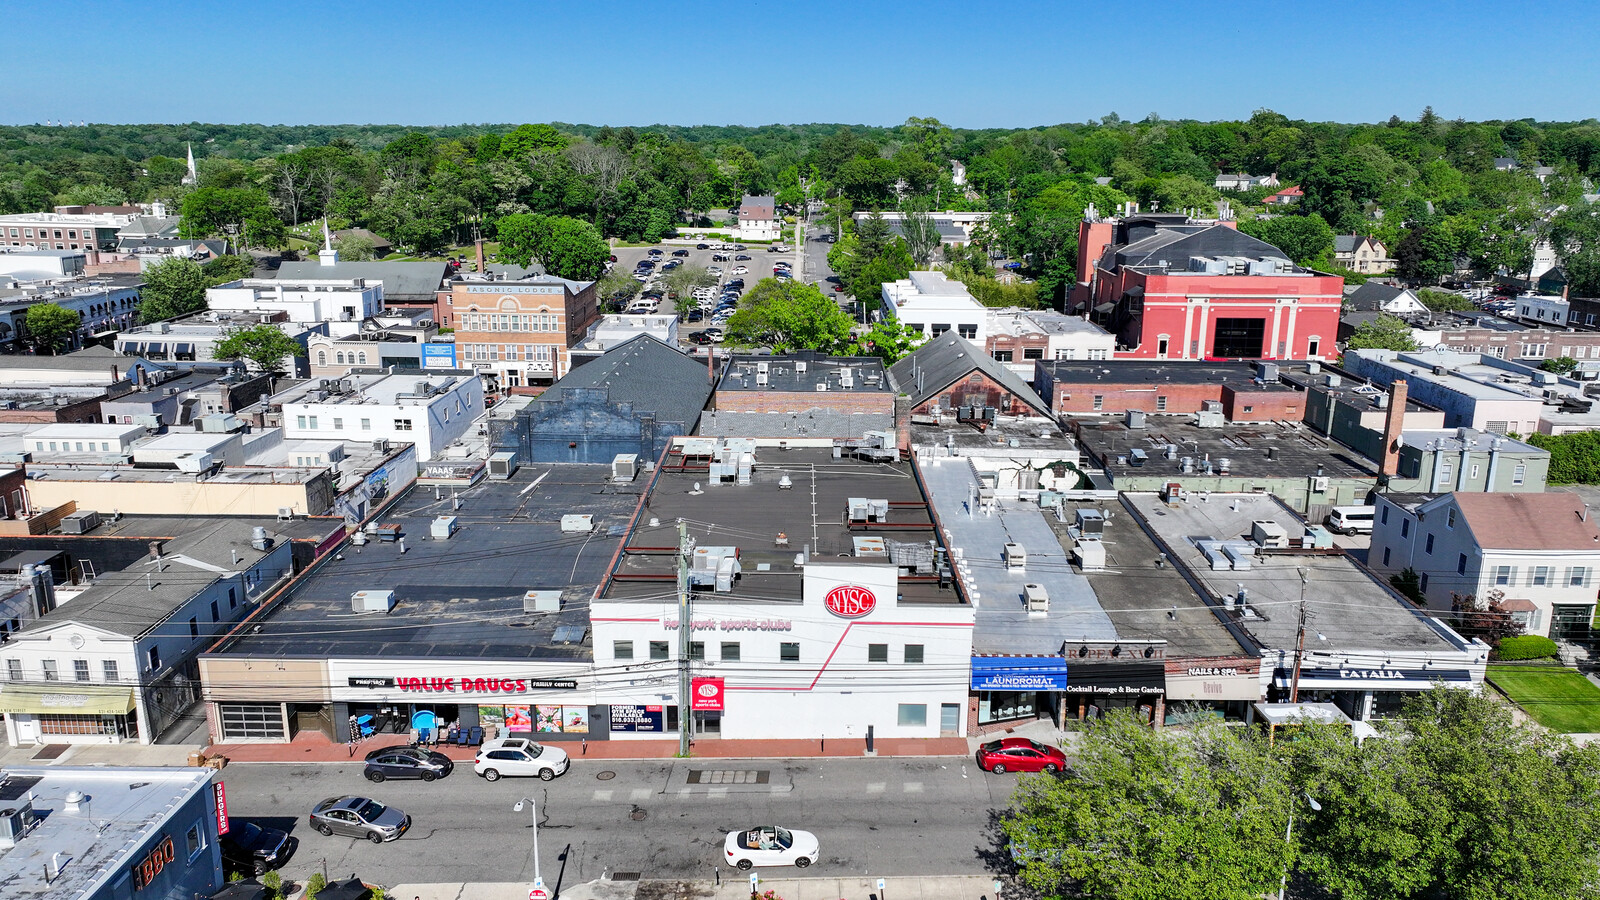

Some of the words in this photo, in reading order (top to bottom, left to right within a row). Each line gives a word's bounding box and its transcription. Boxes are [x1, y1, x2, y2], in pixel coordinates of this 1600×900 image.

[832, 589, 869, 614] NYSC
[664, 620, 681, 630] ne
[691, 619, 717, 631] york
[720, 619, 757, 632] sports
[760, 618, 792, 631] clubs
[1127, 649, 1164, 659] XVII
[1188, 667, 1212, 676] NAILS
[1212, 667, 1221, 675] &
[1221, 668, 1238, 676] SPA
[396, 677, 454, 691] VALUE
[461, 678, 527, 692] DRUGS
[985, 677, 1054, 685] LAUNDROMAT
[1066, 685, 1092, 693] Cocktail
[1093, 685, 1118, 694] Lounge
[217, 783, 226, 829] BURGERS
[143, 839, 175, 887] BBQ
